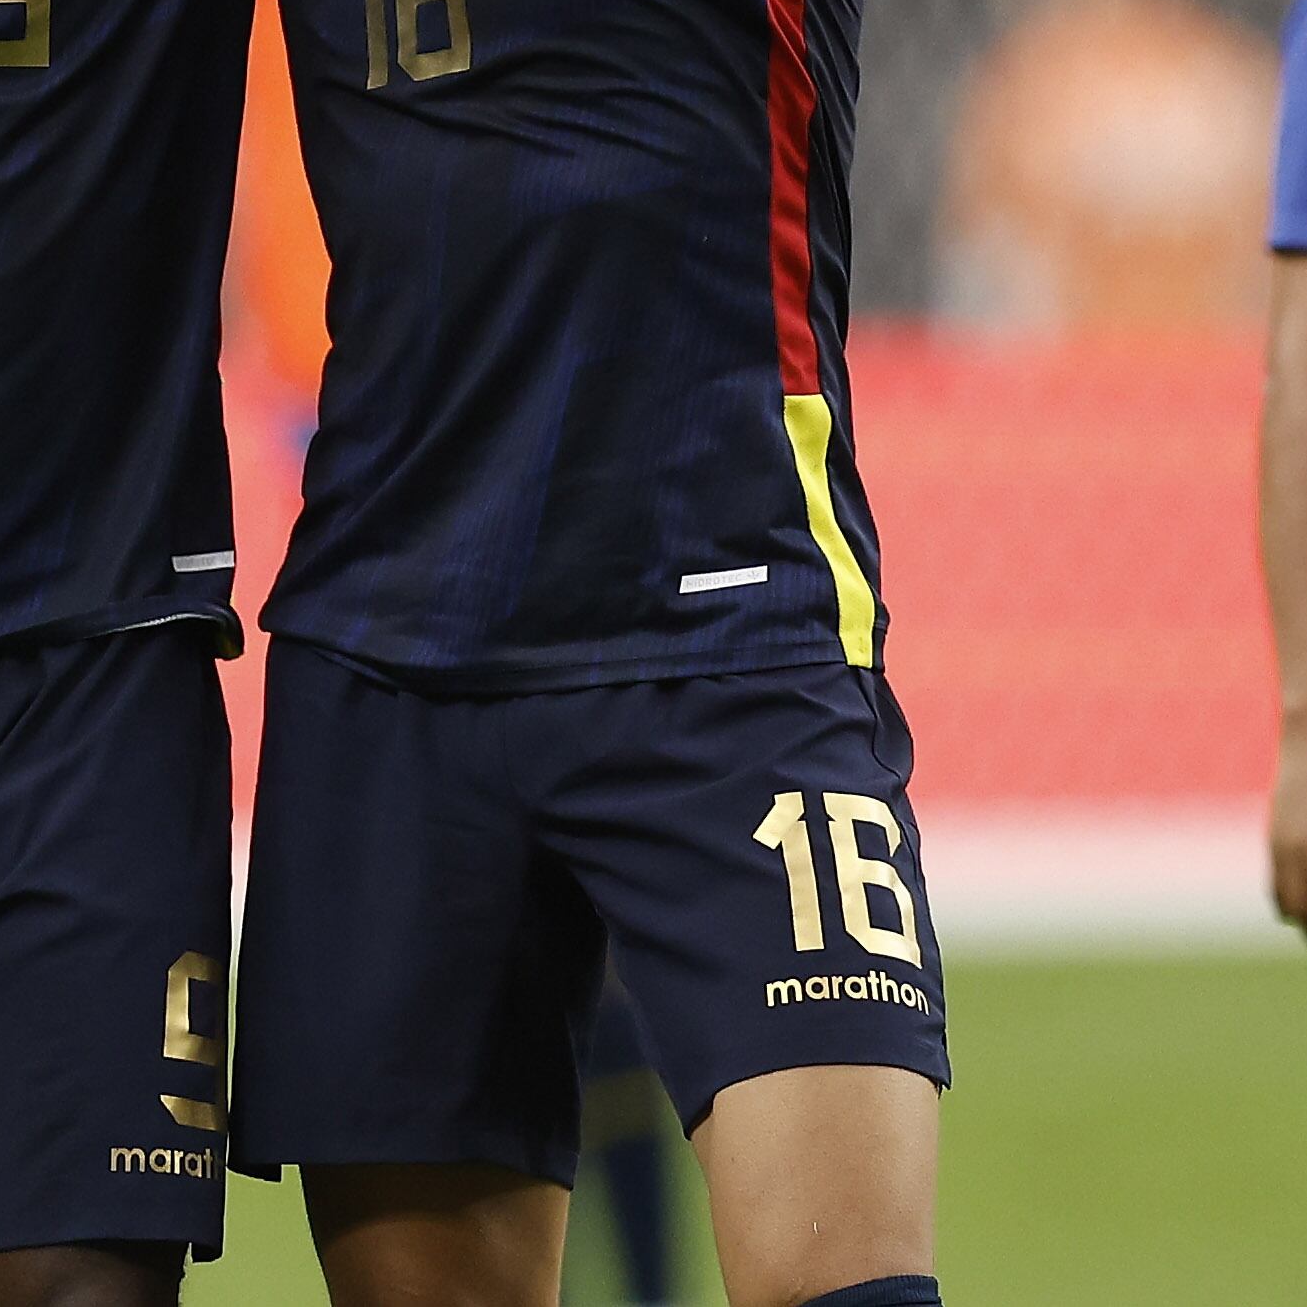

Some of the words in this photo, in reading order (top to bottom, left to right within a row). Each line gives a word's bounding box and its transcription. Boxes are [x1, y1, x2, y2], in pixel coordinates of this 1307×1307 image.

[752, 791, 923, 970] 16
[159, 950, 228, 1133] 9
[765, 970, 930, 1016] marathon
[110, 1147, 217, 1180] marat
